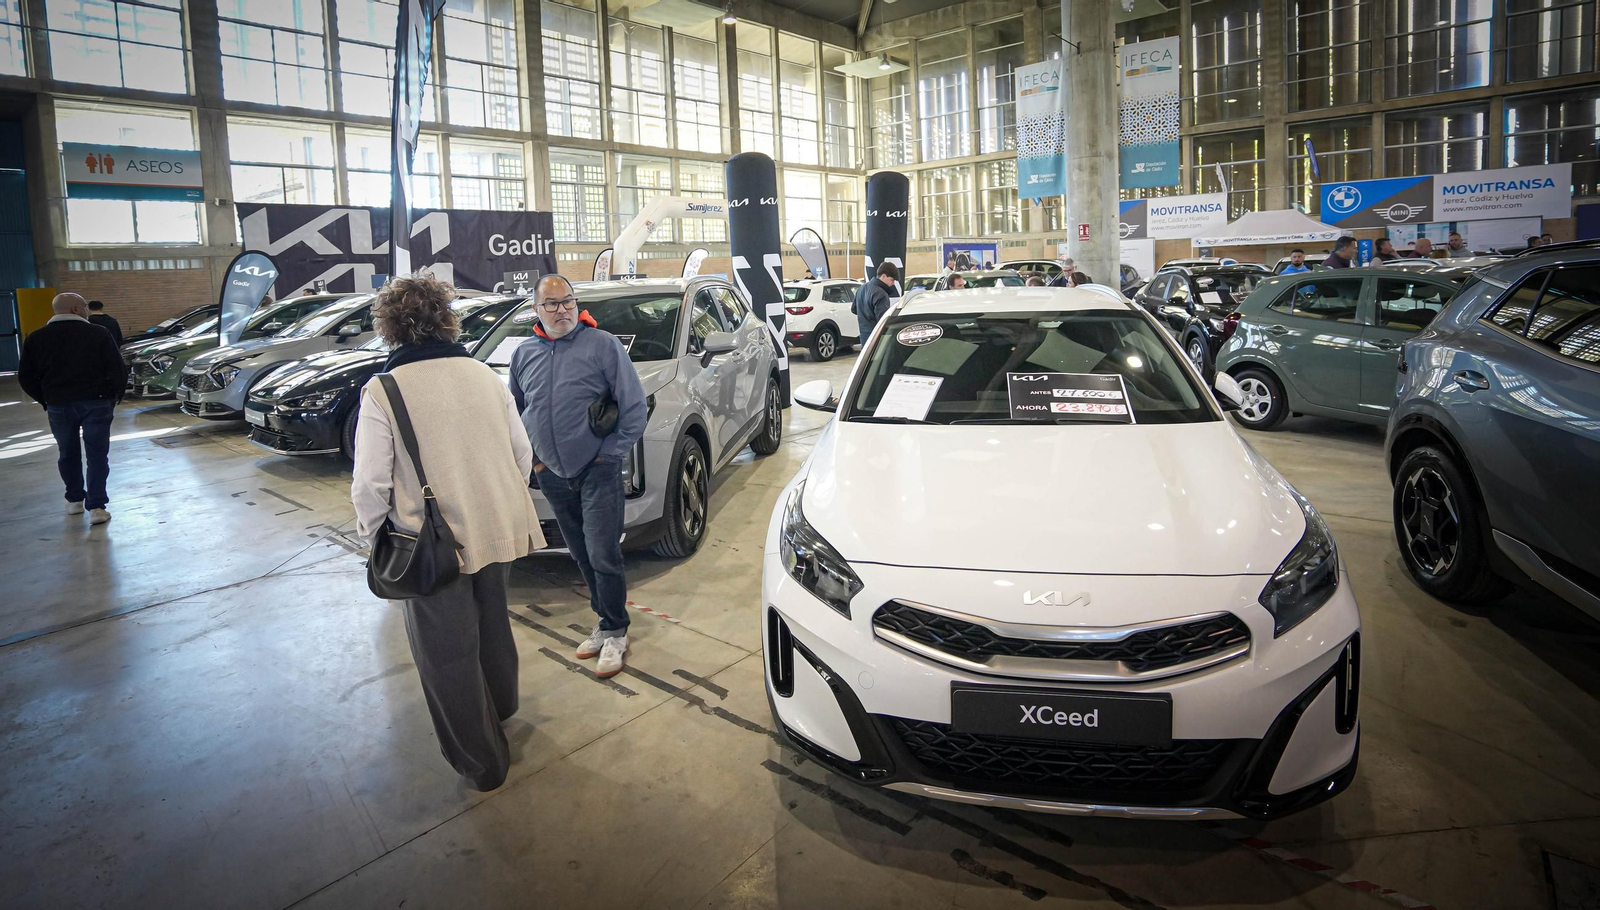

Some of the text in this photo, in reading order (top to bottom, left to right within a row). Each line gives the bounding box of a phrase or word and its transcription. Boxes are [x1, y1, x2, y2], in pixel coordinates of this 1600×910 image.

[1125, 49, 1173, 68] IFECA
[1019, 70, 1060, 88] IFECA
[126, 159, 184, 174] ASEOS
[1442, 177, 1556, 195] MOVITRANSA
[1502, 192, 1534, 200] Huelva
[1151, 203, 1223, 216] MOVITRANSA
[1442, 202, 1523, 213] www.movitran.com
[488, 233, 554, 256] Gadir
[234, 264, 276, 279] KIA
[232, 279, 250, 287] Gadir
[1023, 589, 1092, 607] KIA
[1019, 704, 1099, 728] XCeed
